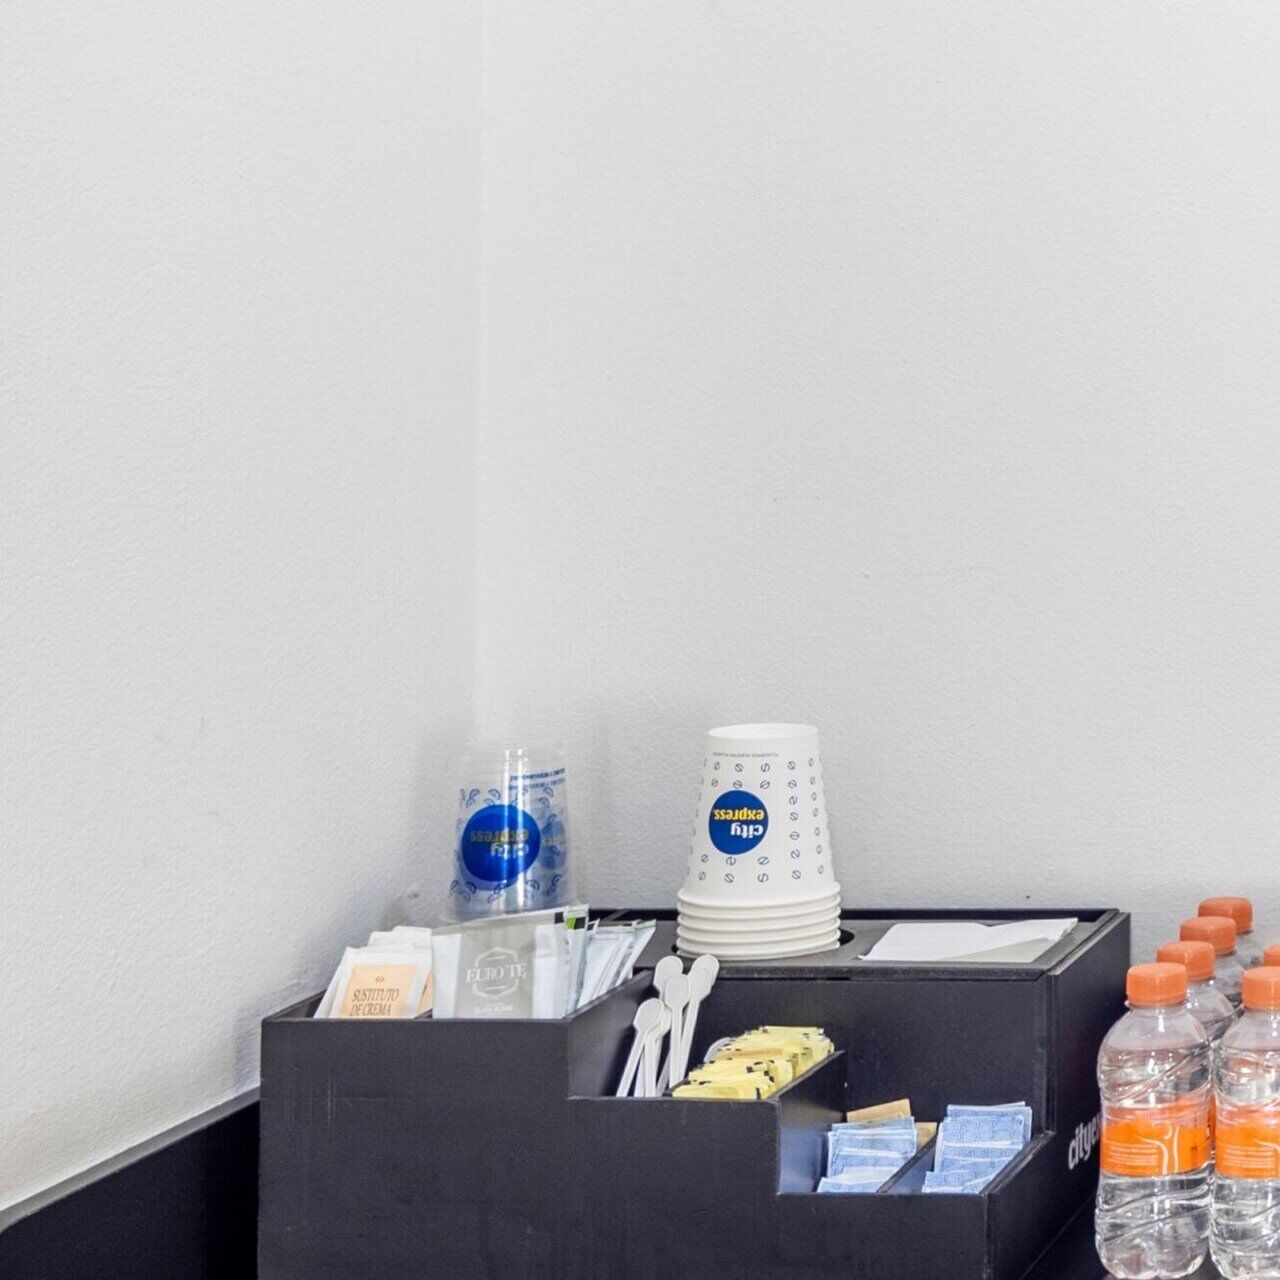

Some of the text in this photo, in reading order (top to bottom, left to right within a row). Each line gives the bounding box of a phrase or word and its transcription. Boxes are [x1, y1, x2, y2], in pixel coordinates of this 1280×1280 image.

[714, 807, 764, 821] express
[470, 828, 529, 843] express
[729, 822, 764, 838] city
[490, 843, 529, 859] city
[466, 966, 504, 982] EURO
[352, 988, 400, 1002] SUSTITUTO
[350, 1003, 392, 1016] DE CREMA
